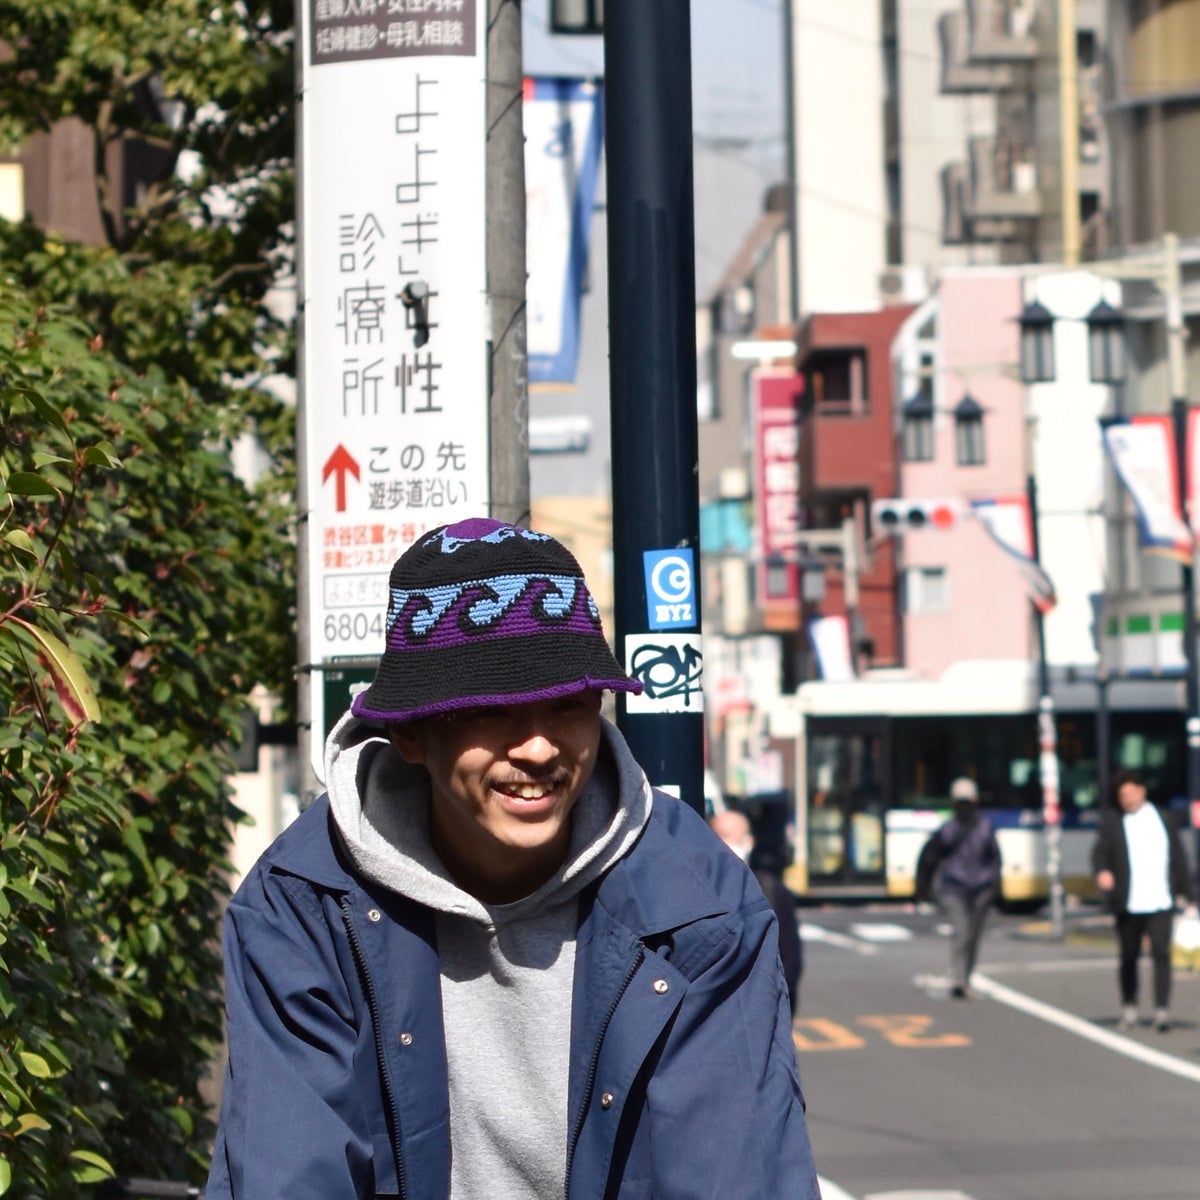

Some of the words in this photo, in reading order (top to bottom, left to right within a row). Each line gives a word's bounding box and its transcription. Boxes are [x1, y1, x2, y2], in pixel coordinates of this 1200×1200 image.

[336, 213, 385, 416] 診療所
[369, 442, 466, 473] この先
[368, 478, 467, 510] 遊歩道沿い
[655, 604, 692, 623] BYZ
